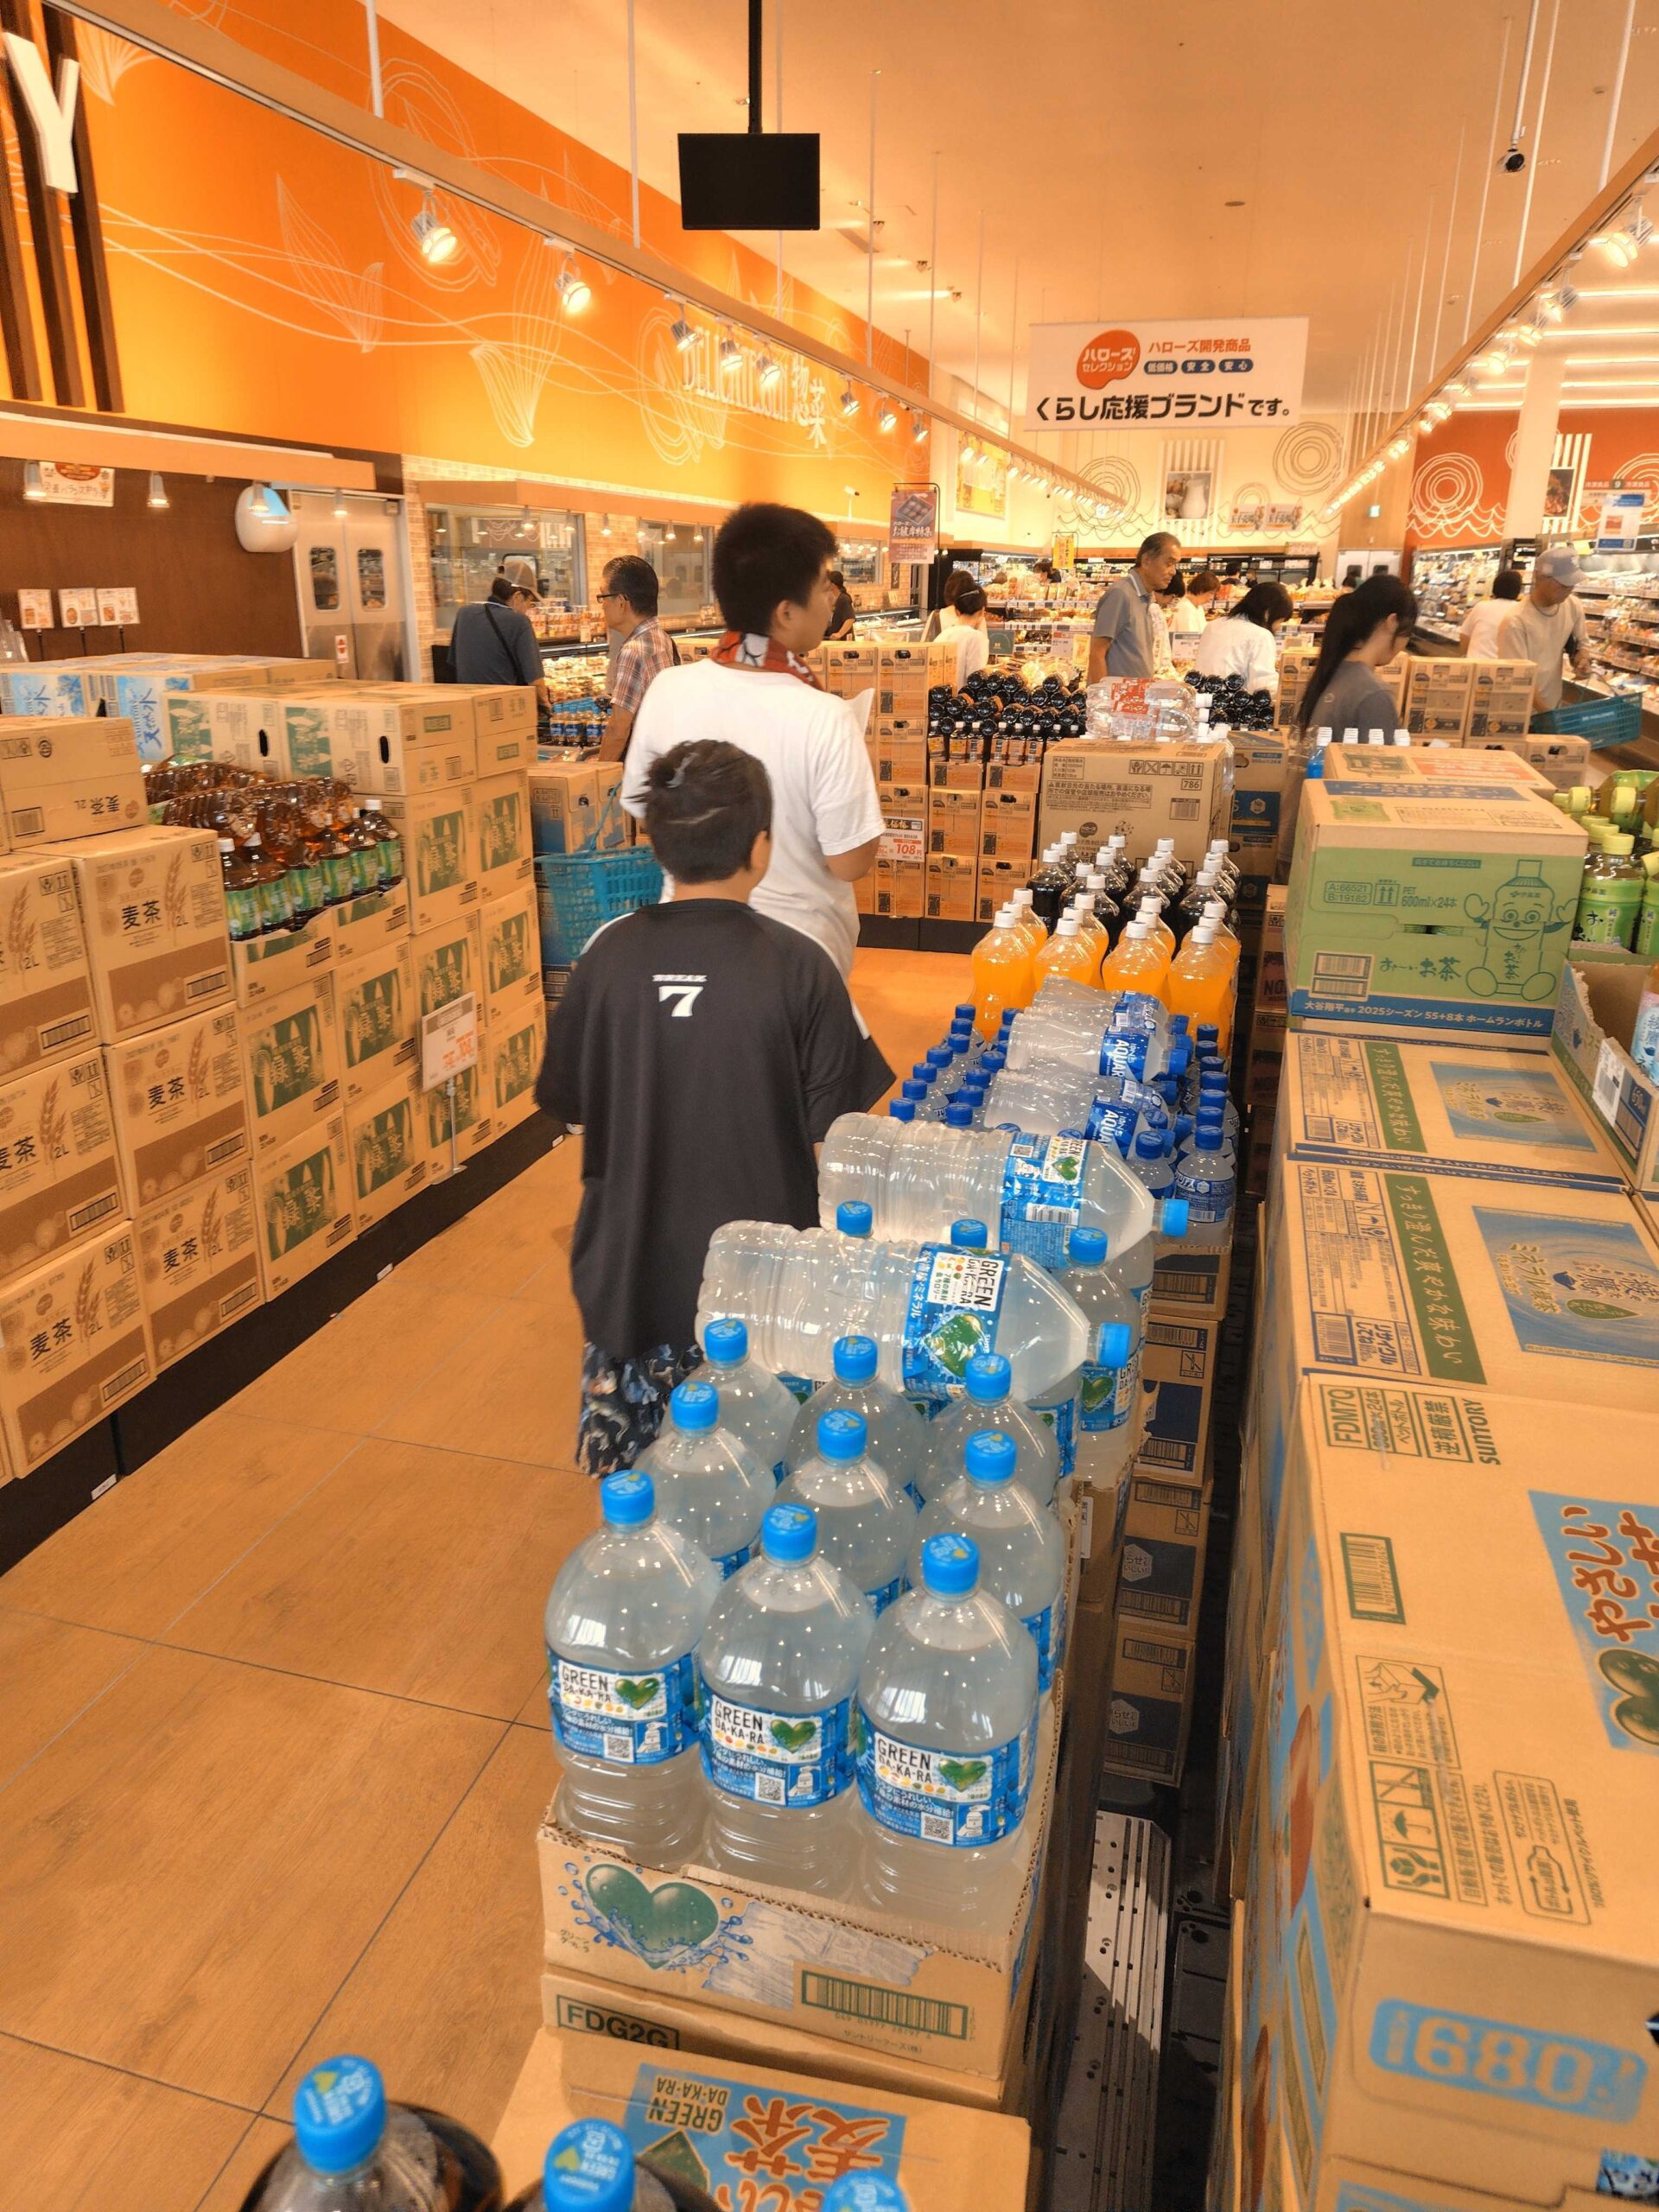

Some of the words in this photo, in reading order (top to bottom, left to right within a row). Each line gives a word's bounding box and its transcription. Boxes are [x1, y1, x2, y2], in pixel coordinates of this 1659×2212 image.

[3, 32, 80, 194] Y
[1083, 346, 1136, 362] ハローズ
[1148, 338, 1252, 354] ハローズ開発商品
[1082, 361, 1134, 374] セレクション
[1036, 392, 1292, 422] くらし応援ブランドです。
[1183, 780, 1200, 790] 786
[121, 899, 162, 931] 麦茶
[175, 915, 189, 928] 2L
[658, 985, 704, 1017] 7
[1465, 1014, 1545, 1028] ホームランボトル
[147, 1076, 186, 1109] 麦茶
[54, 1145, 70, 1160] 2L
[162, 1236, 199, 1274] 麦茶
[1395, 1183, 1465, 1365] すっきり澄んだ爽やかな味わい
[29, 1317, 73, 1362] 麦茶
[88, 1322, 105, 1337] 2L
[1373, 1323, 1399, 1365] リサイクル
[1328, 1389, 1363, 1445] FDM7Q
[1391, 1397, 1411, 1445] ペットボトル
[1425, 1400, 1462, 1457] 逆積厳禁
[1560, 1506, 1653, 1643] やさしい
[562, 1665, 609, 1693] GREEN
[714, 1700, 764, 1731] GREEN
[877, 1738, 932, 1771] GREEN
[648, 2096, 724, 2133] GREEN
[724, 2095, 891, 2181] 麦茶
